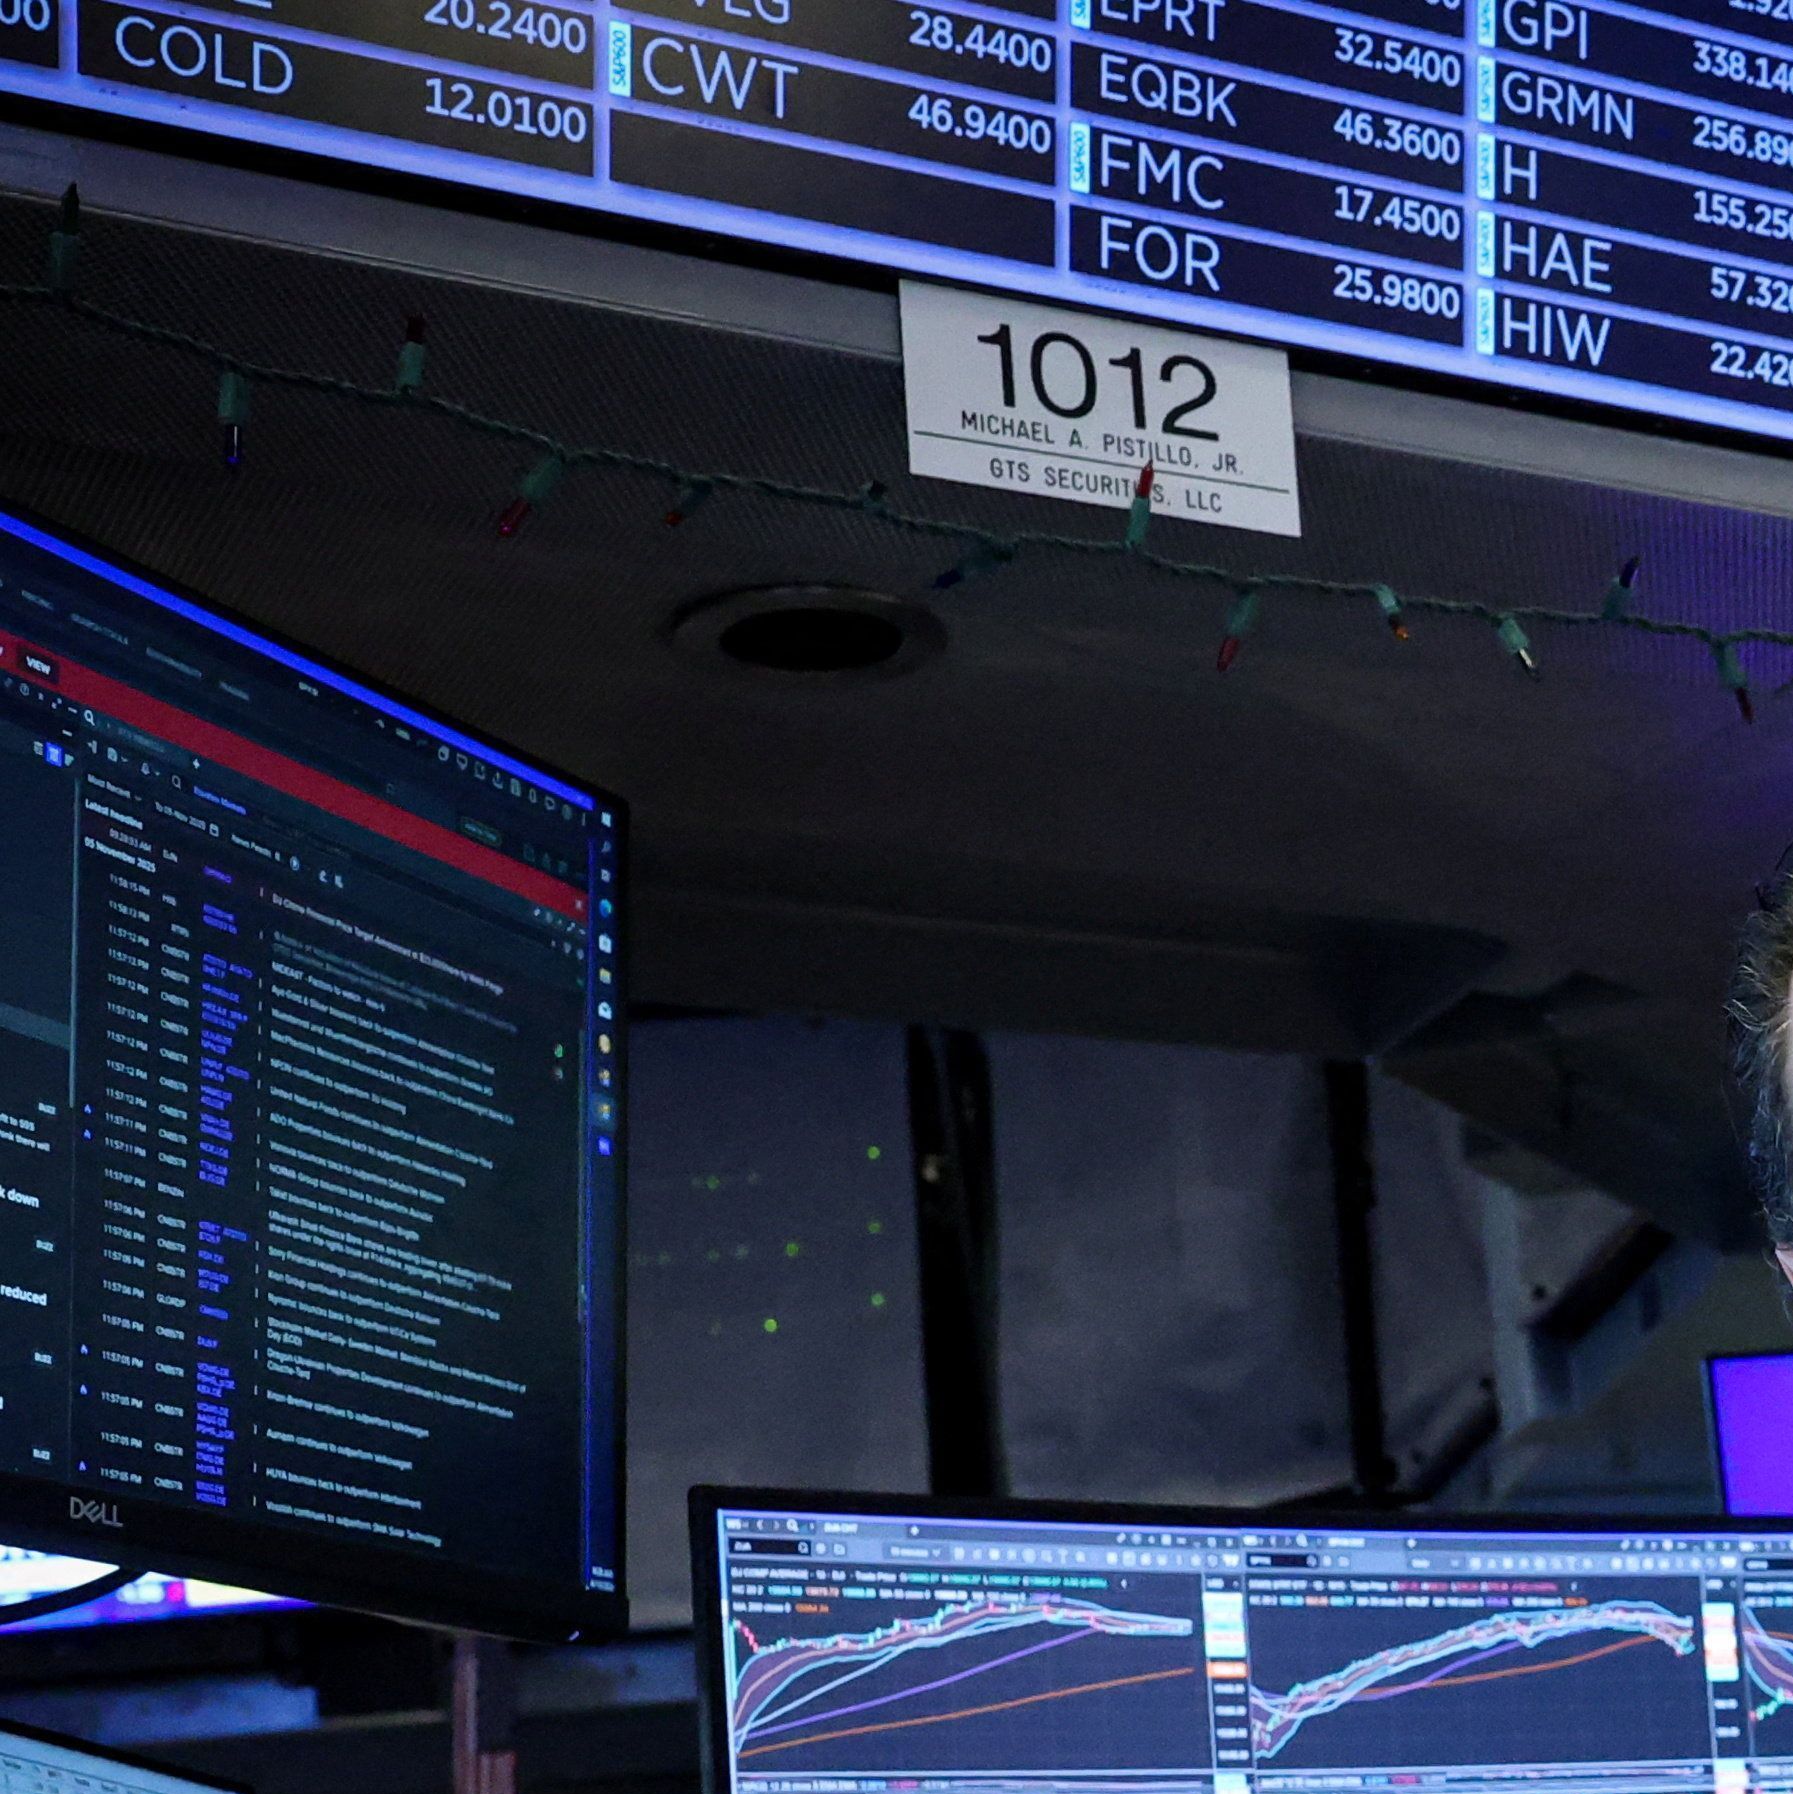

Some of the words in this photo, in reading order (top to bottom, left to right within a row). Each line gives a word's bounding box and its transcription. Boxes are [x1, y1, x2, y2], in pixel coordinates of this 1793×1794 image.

[424, 0, 587, 54] 20.2400
[909, 10, 1051, 73] 28.4400
[1334, 28, 1461, 88] 32.5400
[1503, 0, 1588, 60] GPI
[115, 15, 293, 95] COLD
[425, 77, 586, 143] 12.0100
[642, 37, 798, 119] CWT
[908, 95, 1051, 154] 46.9400
[1100, 54, 1237, 128] EQBK
[1334, 109, 1461, 166] 46.3600
[1502, 70, 1634, 140] GRMN
[1101, 134, 1224, 210] FMC
[1334, 185, 1461, 242] 17.4500
[1503, 144, 1538, 200] H
[1100, 216, 1220, 292] FOR
[1334, 265, 1461, 319] 25.9800
[1503, 220, 1612, 293] HAE
[1503, 297, 1611, 366] HIW
[977, 323, 1220, 442] 1012
[961, 410, 1055, 445] MICHAEL
[1068, 429, 1088, 450] A.
[1212, 453, 1244, 476] JR.
[990, 458, 1030, 482] GTS
[1185, 489, 1223, 514] LLC
[7, 1188, 39, 1208] down
[0, 1284, 47, 1307] reduced
[70, 1496, 123, 1528] DELL
